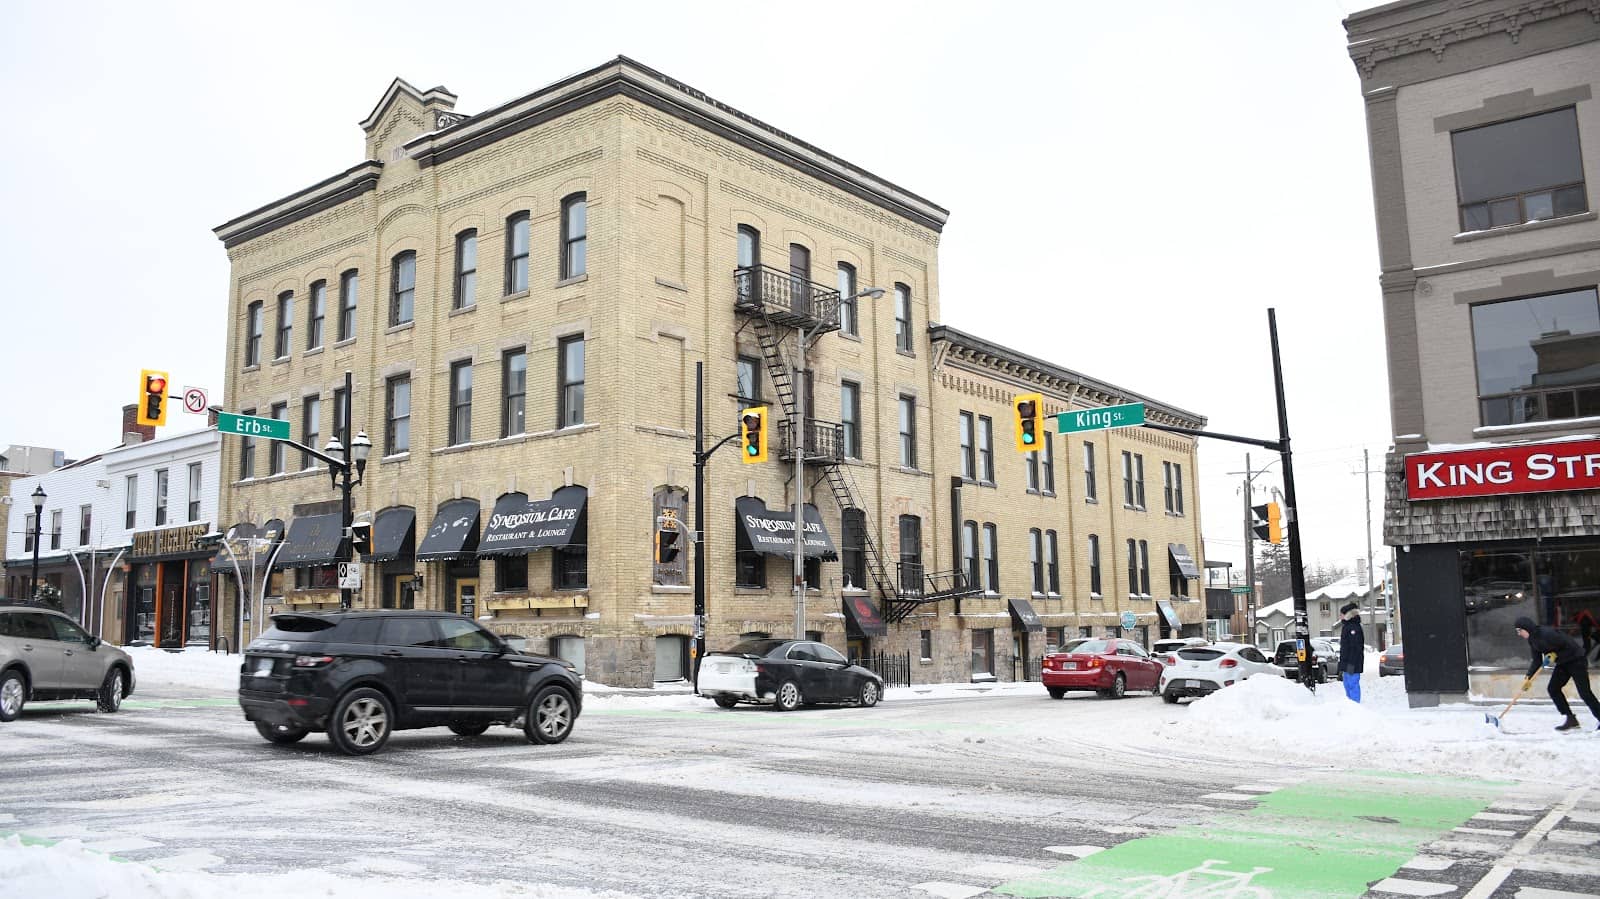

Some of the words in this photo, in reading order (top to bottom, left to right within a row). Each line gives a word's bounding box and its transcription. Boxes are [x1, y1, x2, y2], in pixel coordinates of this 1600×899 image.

[236, 418, 261, 433] Erb
[262, 424, 273, 432] St.
[1076, 411, 1111, 427] King
[1113, 413, 1124, 421] St.
[1416, 460, 1514, 489] KING
[489, 511, 547, 530] SYMPOSIUM
[547, 507, 577, 522] CAFE
[745, 514, 796, 532] SYMPOSIUM
[486, 531, 528, 542] RESTAURANT
[528, 530, 536, 538] &
[537, 528, 567, 538] LOUNGE
